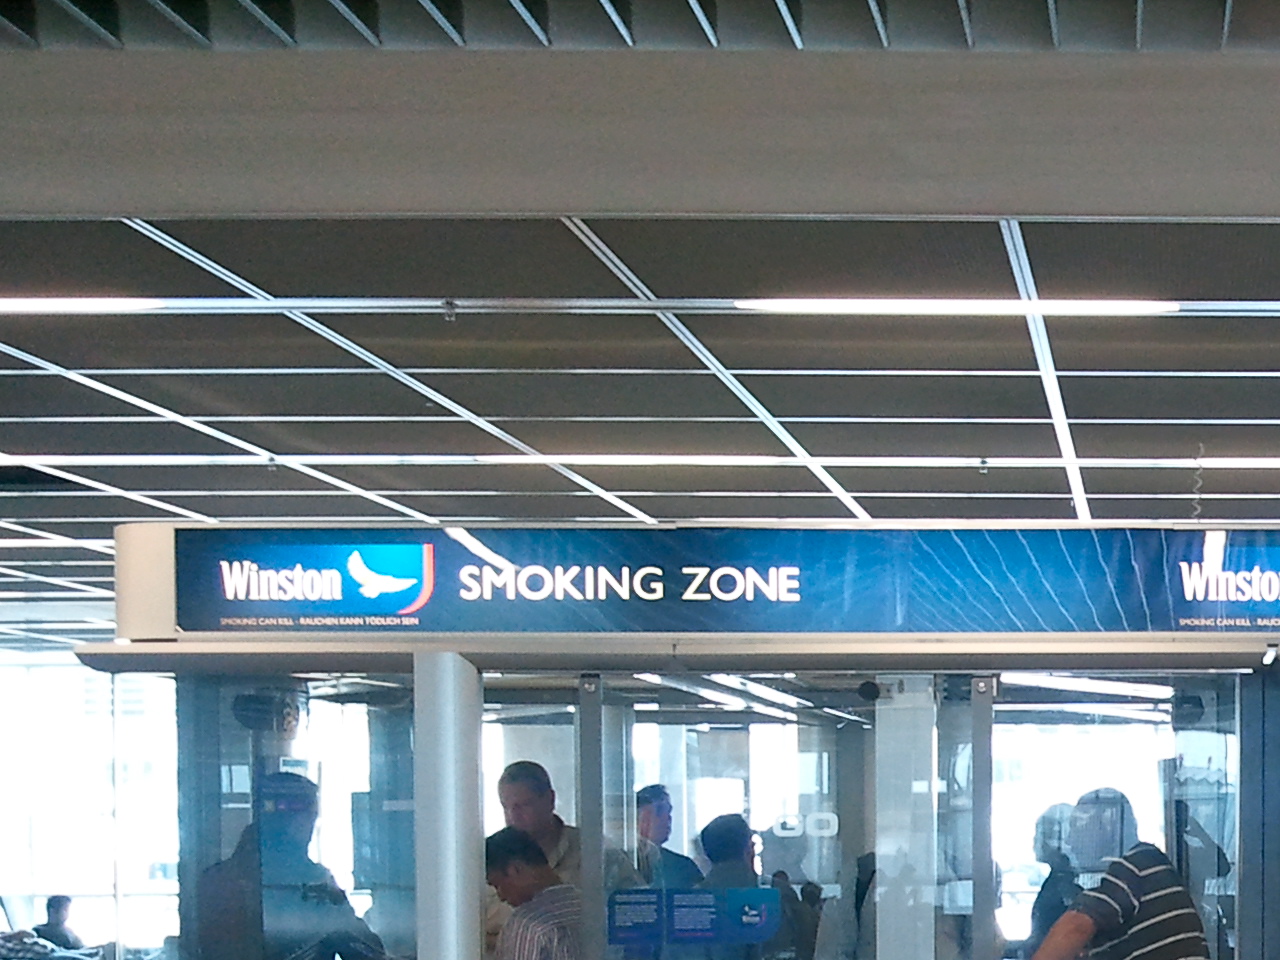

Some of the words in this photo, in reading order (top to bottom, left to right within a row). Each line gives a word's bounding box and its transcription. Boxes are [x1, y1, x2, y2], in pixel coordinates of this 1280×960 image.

[219, 560, 343, 601] Winston
[458, 565, 664, 601] SMOKING
[681, 566, 801, 601] ZONE
[258, 617, 277, 626] CAN
[1215, 617, 1235, 627] CAN
